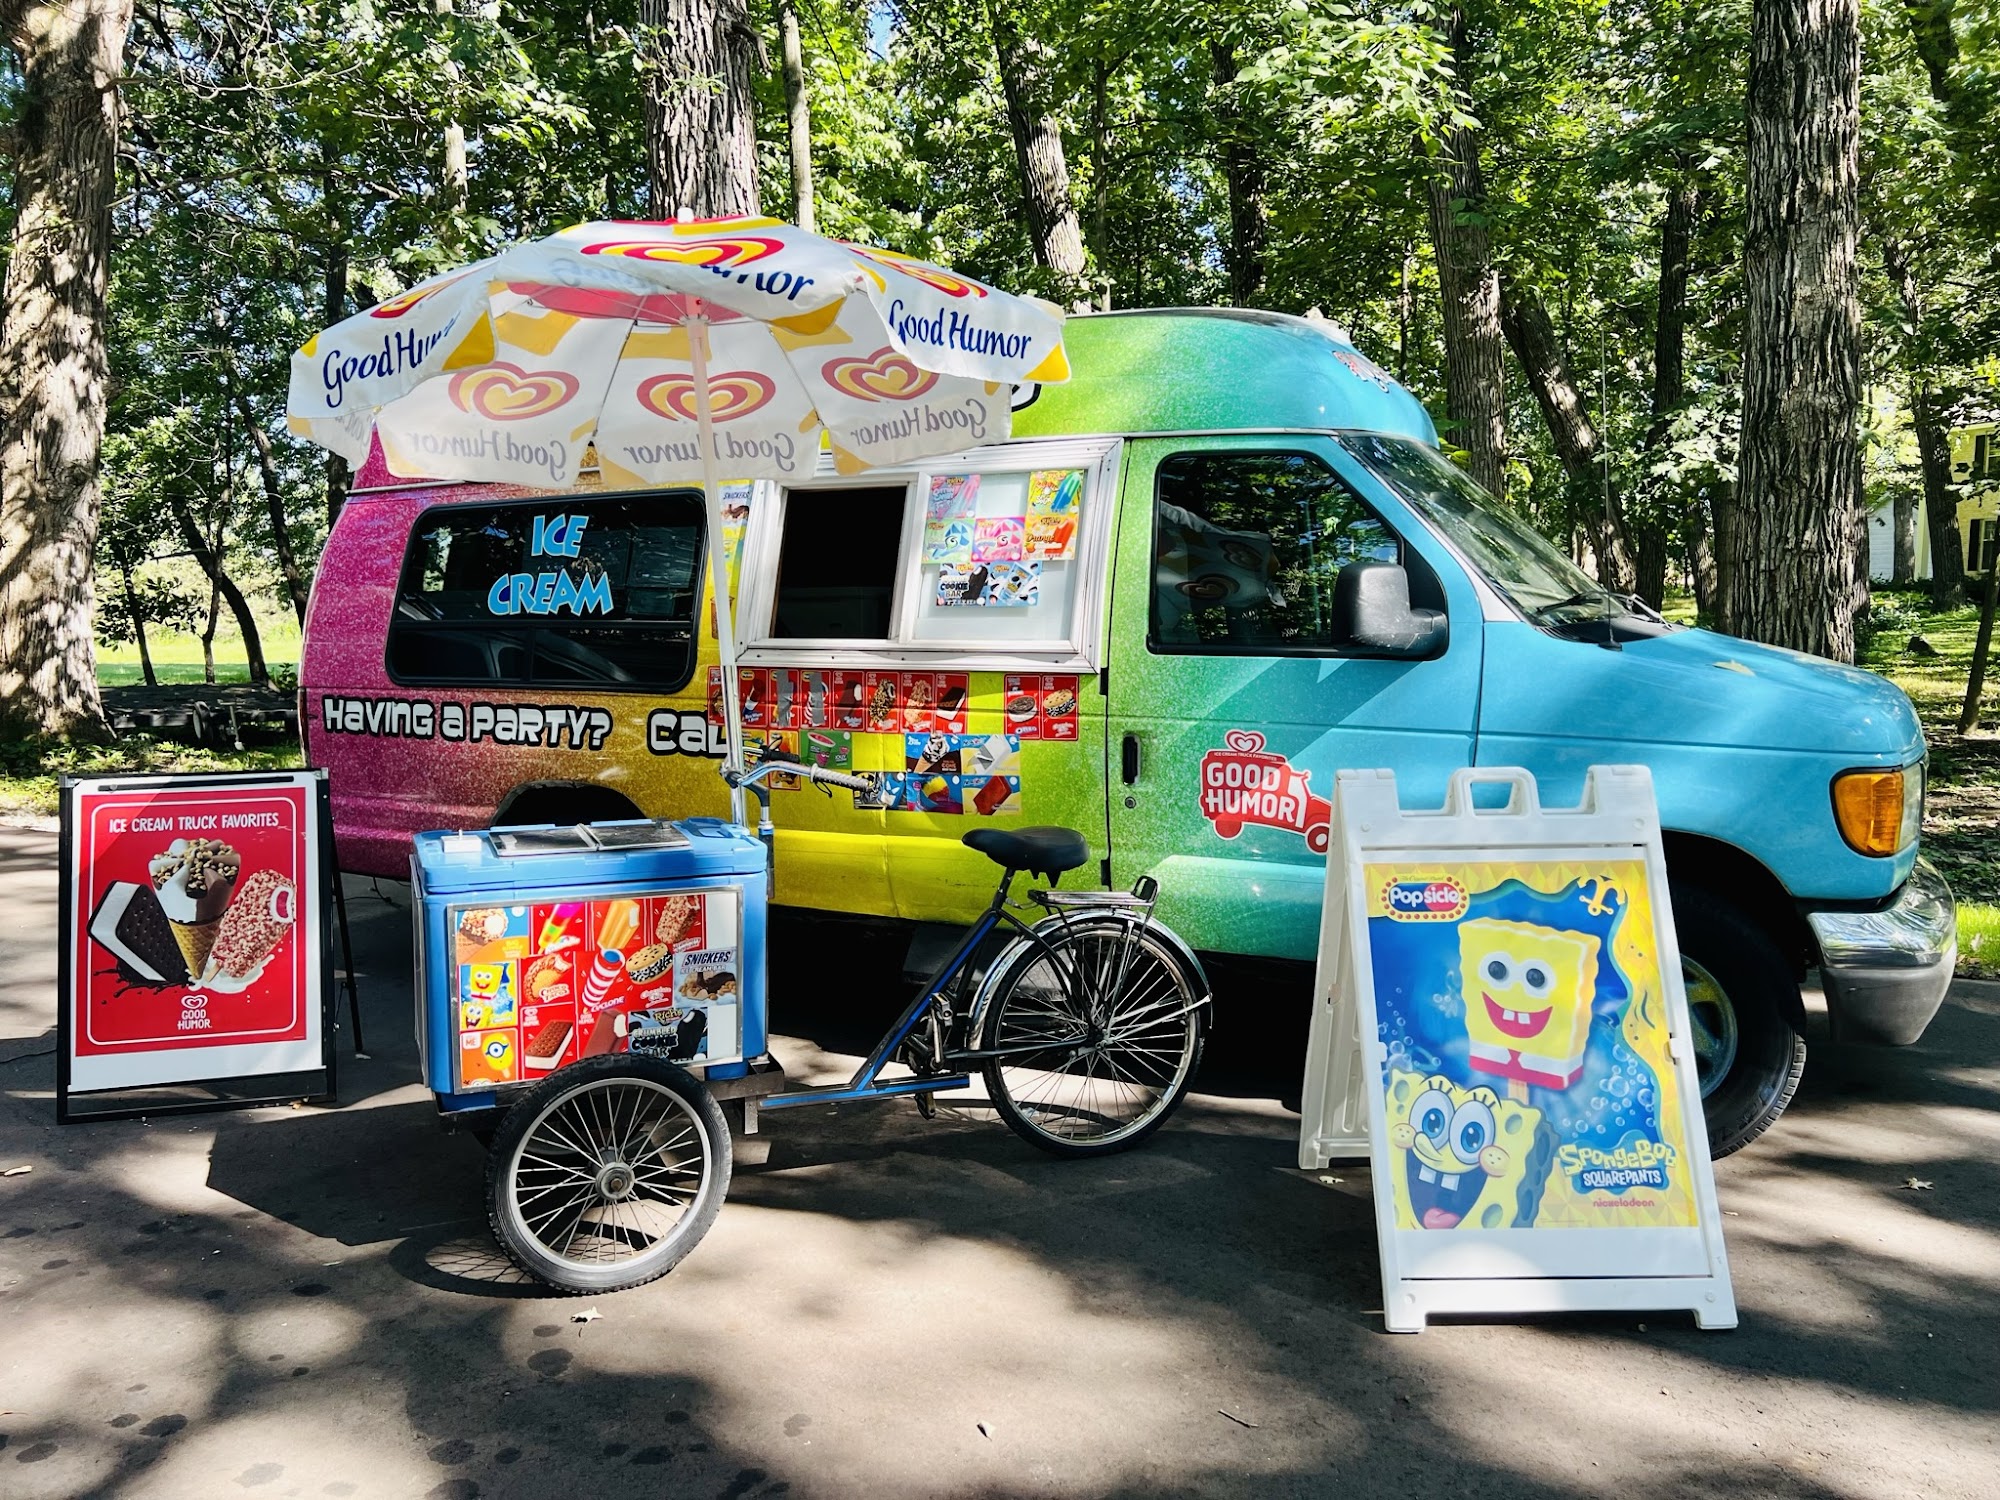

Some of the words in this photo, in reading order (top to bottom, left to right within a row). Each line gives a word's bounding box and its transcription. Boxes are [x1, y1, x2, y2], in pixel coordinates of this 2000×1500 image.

[889, 299, 944, 346] Good
[949, 311, 1032, 359] Humor
[323, 335, 395, 408] Good
[531, 513, 589, 558] ICE
[487, 568, 614, 617] CREAM
[940, 582, 969, 591] COOKIE
[1206, 762, 1281, 792] GOOD
[1205, 788, 1296, 823] HUMOR
[109, 818, 127, 834] ICE
[131, 817, 173, 832] CREAM
[178, 815, 218, 831] TRUCK
[221, 812, 279, 829] FAVORITES
[1389, 886, 1460, 908] Popsicle
[684, 951, 732, 966] SNICKERS
[591, 996, 625, 1012] CYCLONE
[177, 1018, 210, 1030] HUMOR
[181, 1009, 206, 1020] GOOD
[632, 1026, 677, 1038] CRUMBLED
[1582, 1169, 1662, 1188] SQUAREPANTS
[1593, 1198, 1655, 1207] nickelodeon
